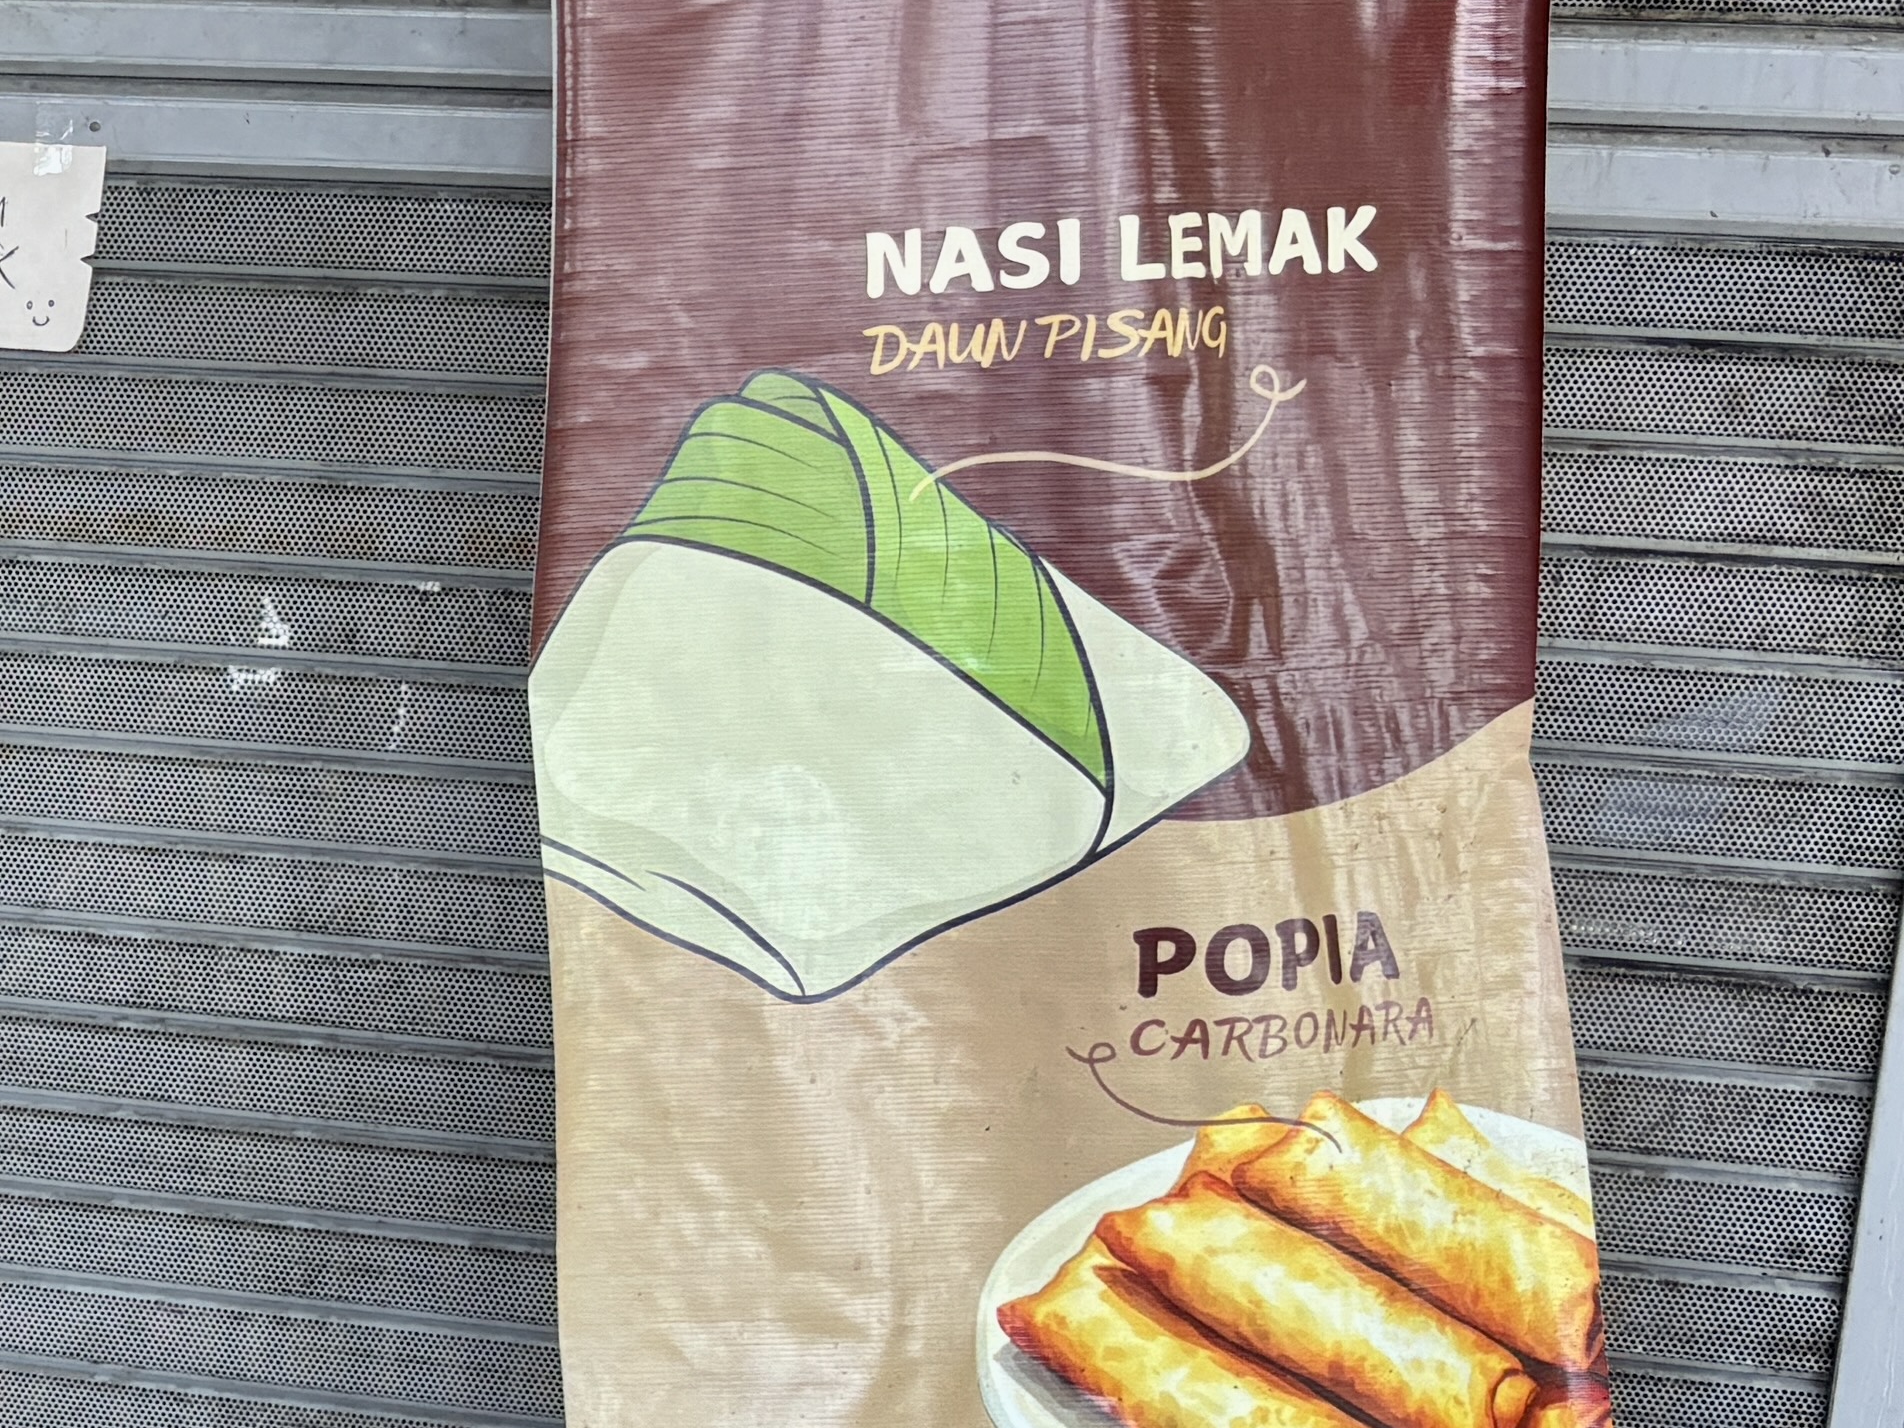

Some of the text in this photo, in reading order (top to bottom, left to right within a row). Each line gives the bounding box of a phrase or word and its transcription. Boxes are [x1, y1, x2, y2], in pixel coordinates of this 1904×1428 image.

[864, 206, 1381, 300] NASI LEMAK
[863, 305, 1228, 376] DAUN PISANG
[1133, 909, 1401, 1001] POPIA
[1129, 1000, 1436, 1064] CARBONARA
